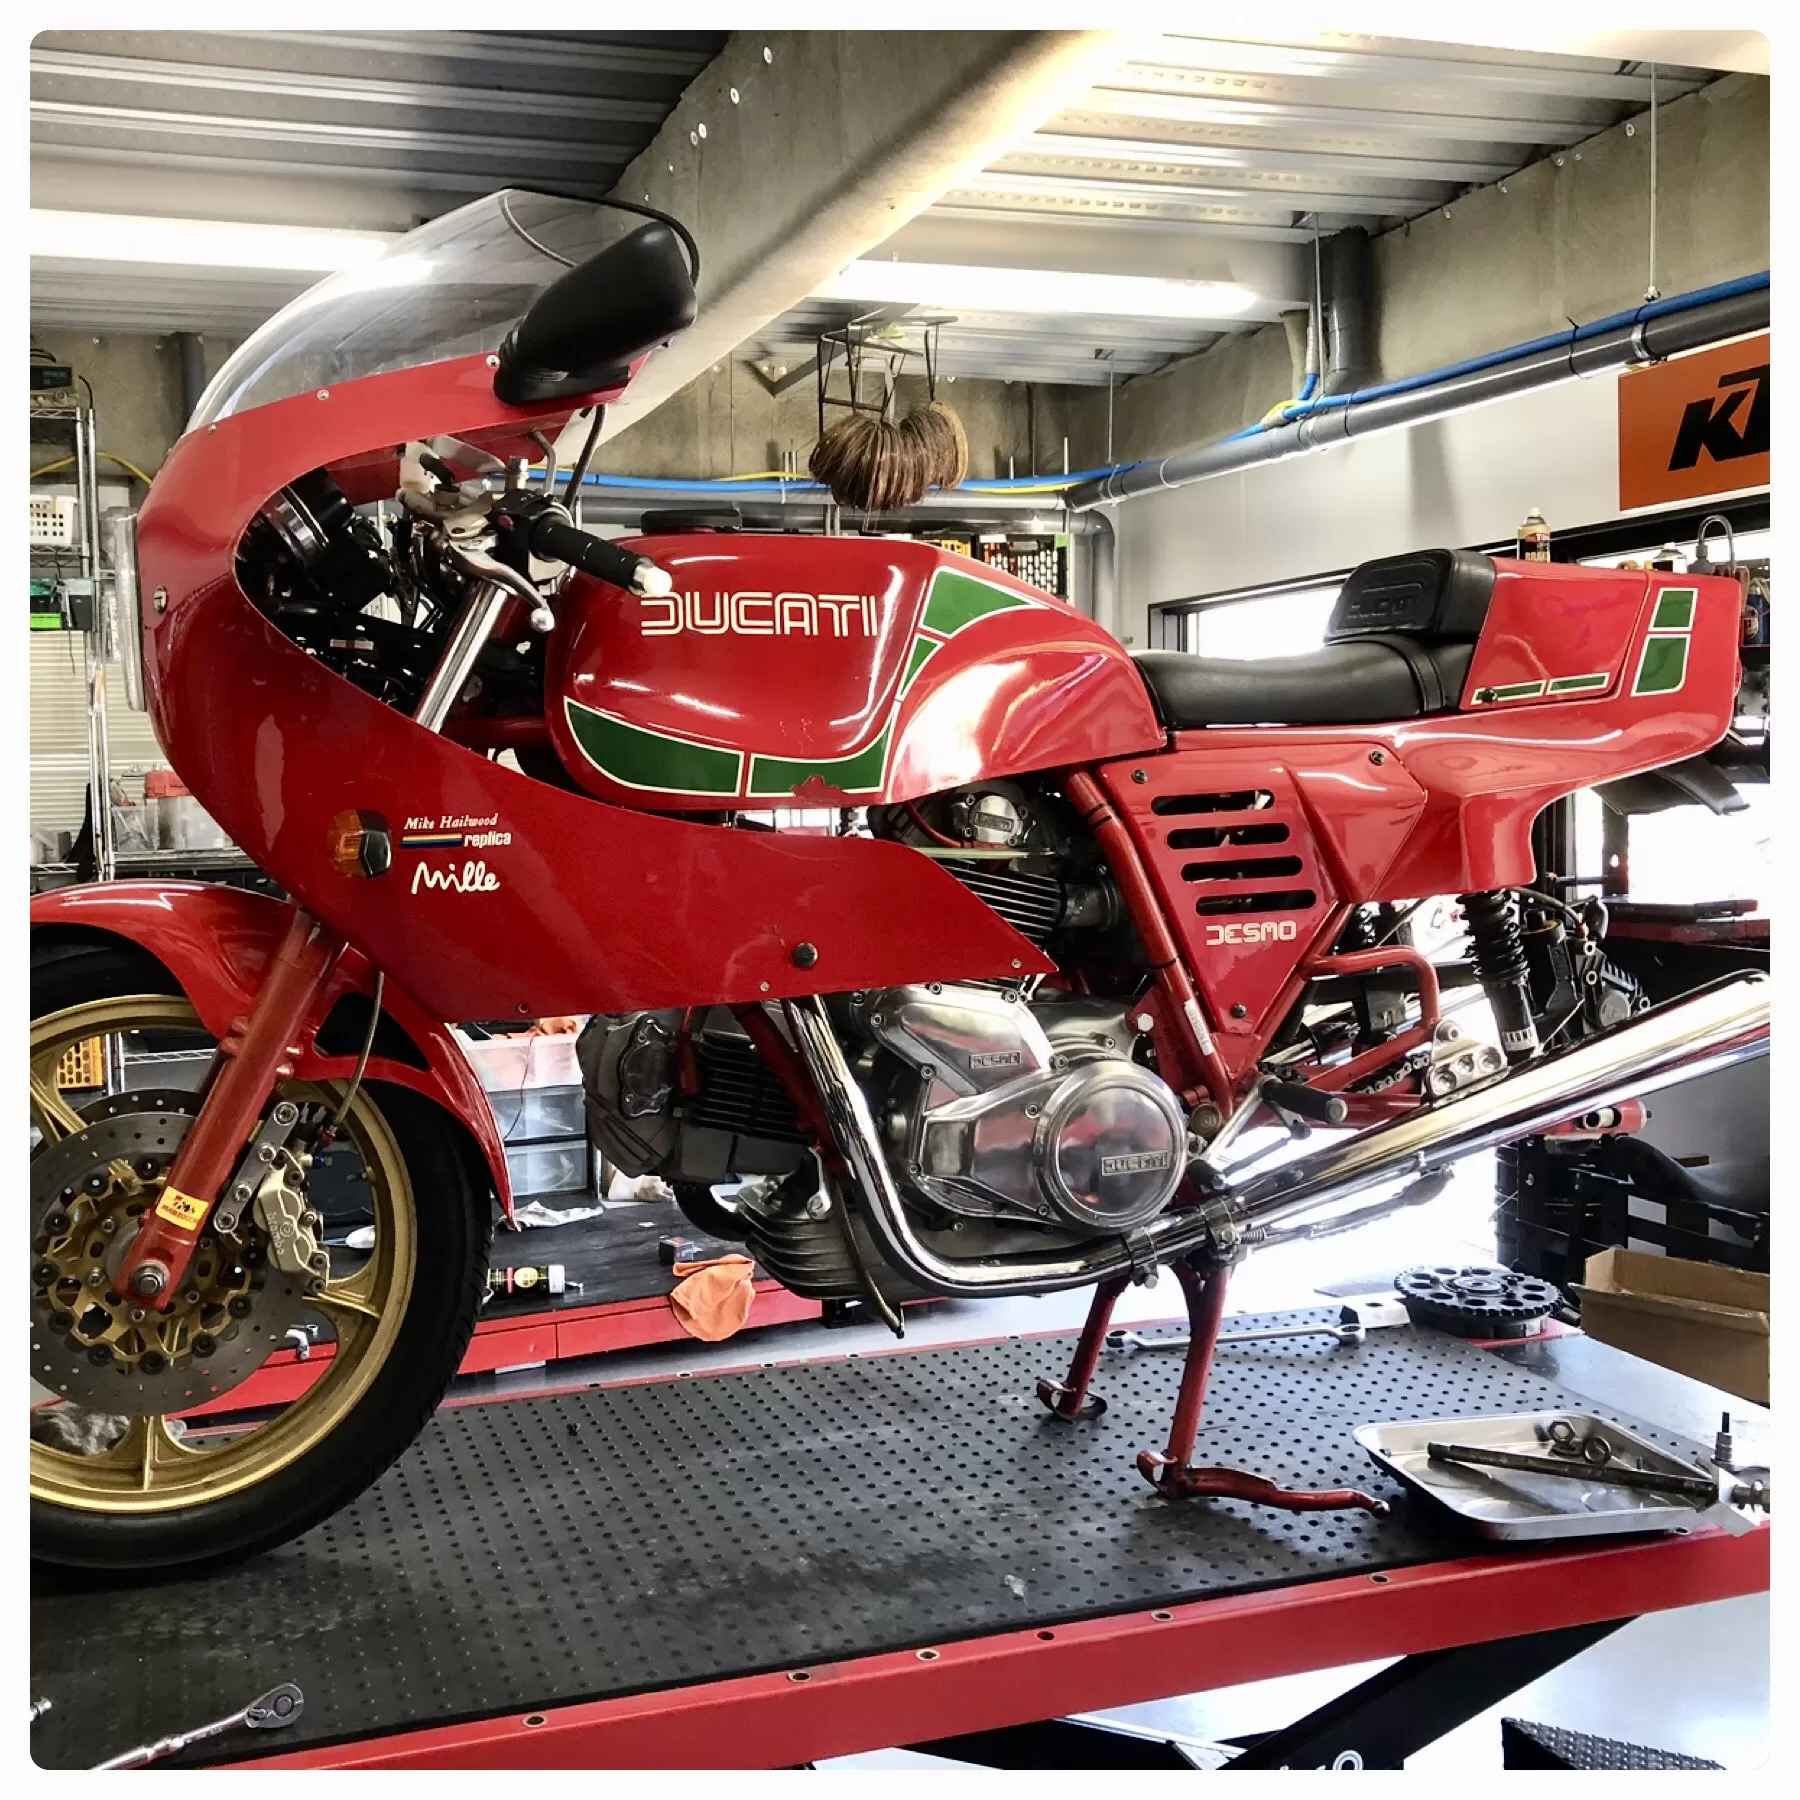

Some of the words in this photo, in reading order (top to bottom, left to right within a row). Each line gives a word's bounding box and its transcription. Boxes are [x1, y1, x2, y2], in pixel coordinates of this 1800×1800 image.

[1667, 364, 1770, 471] KT
[641, 591, 877, 637] DUCATI
[404, 815, 435, 830] Mike
[439, 812, 498, 830] Hailwood
[464, 830, 512, 848] replica
[410, 861, 501, 895] Mille
[1206, 921, 1297, 945] DESMO
